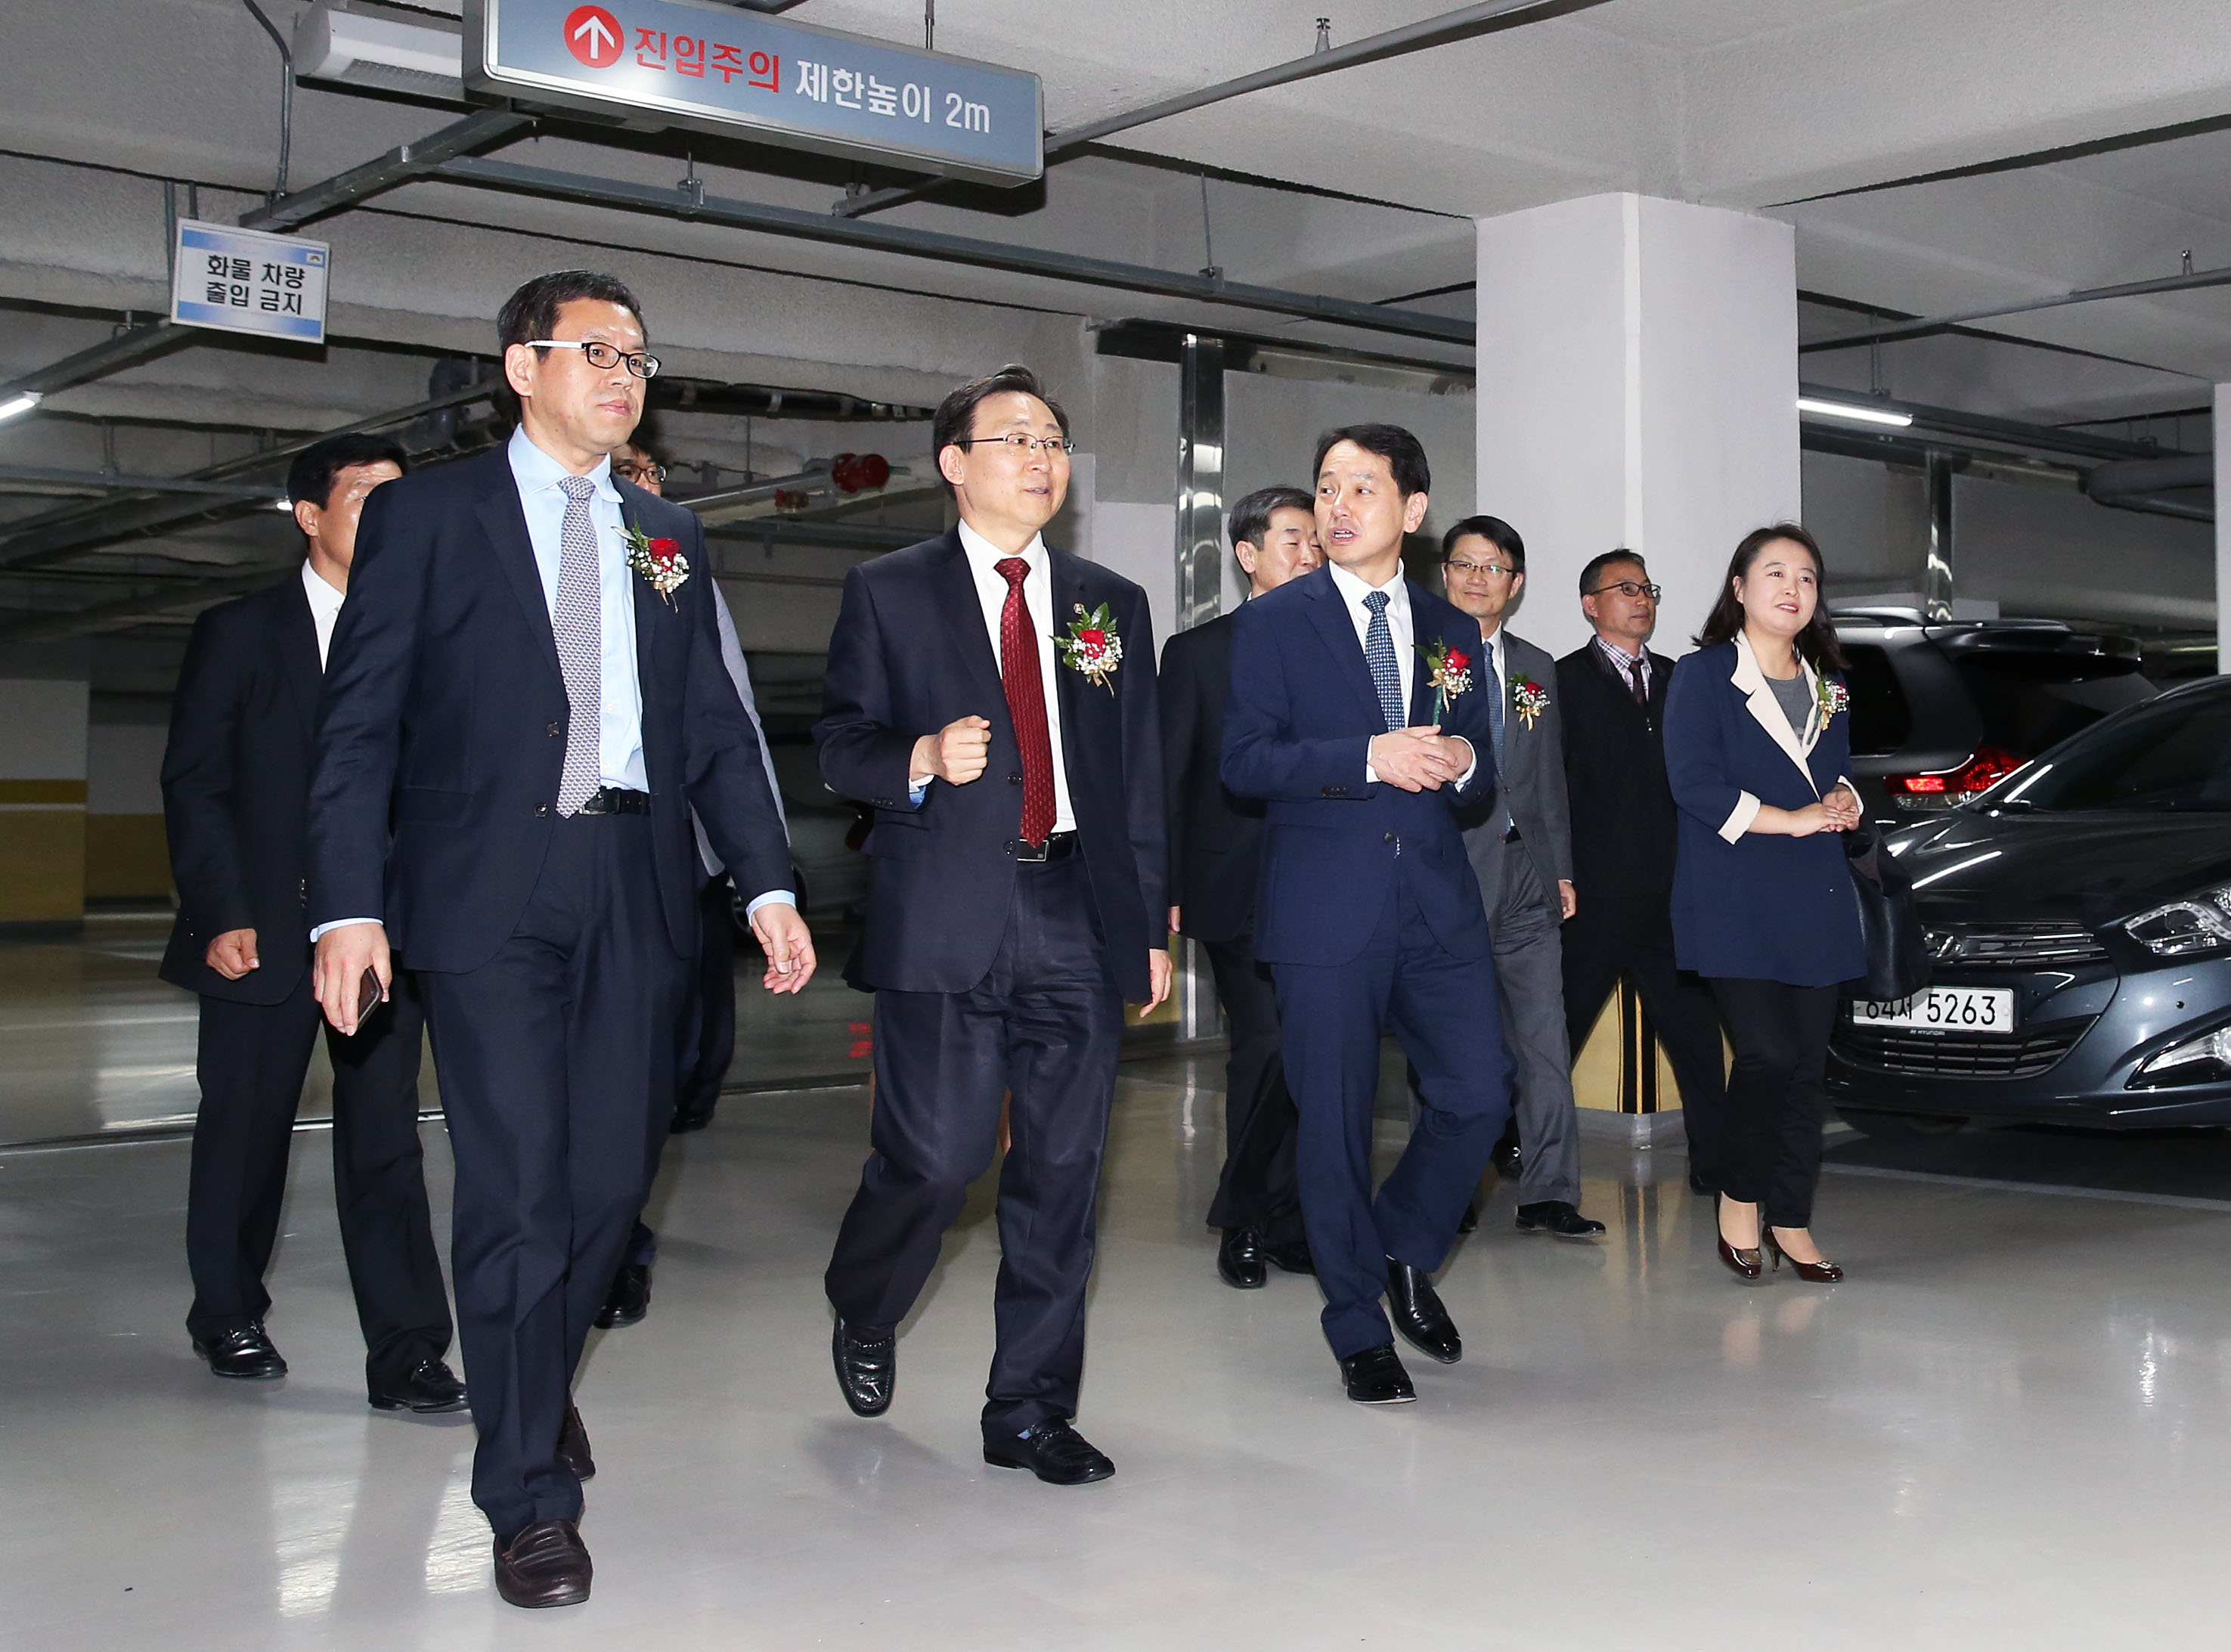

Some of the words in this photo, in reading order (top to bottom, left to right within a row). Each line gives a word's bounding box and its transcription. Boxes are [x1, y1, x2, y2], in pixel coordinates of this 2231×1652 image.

[635, 27, 779, 93] 진입주의
[796, 60, 931, 124] 제한높이
[945, 92, 990, 133] 2m
[206, 254, 252, 281] 화물
[261, 263, 305, 290] 차량
[206, 280, 249, 308] 출입
[260, 289, 302, 315] 금지
[1927, 993, 1996, 1025] 5263
